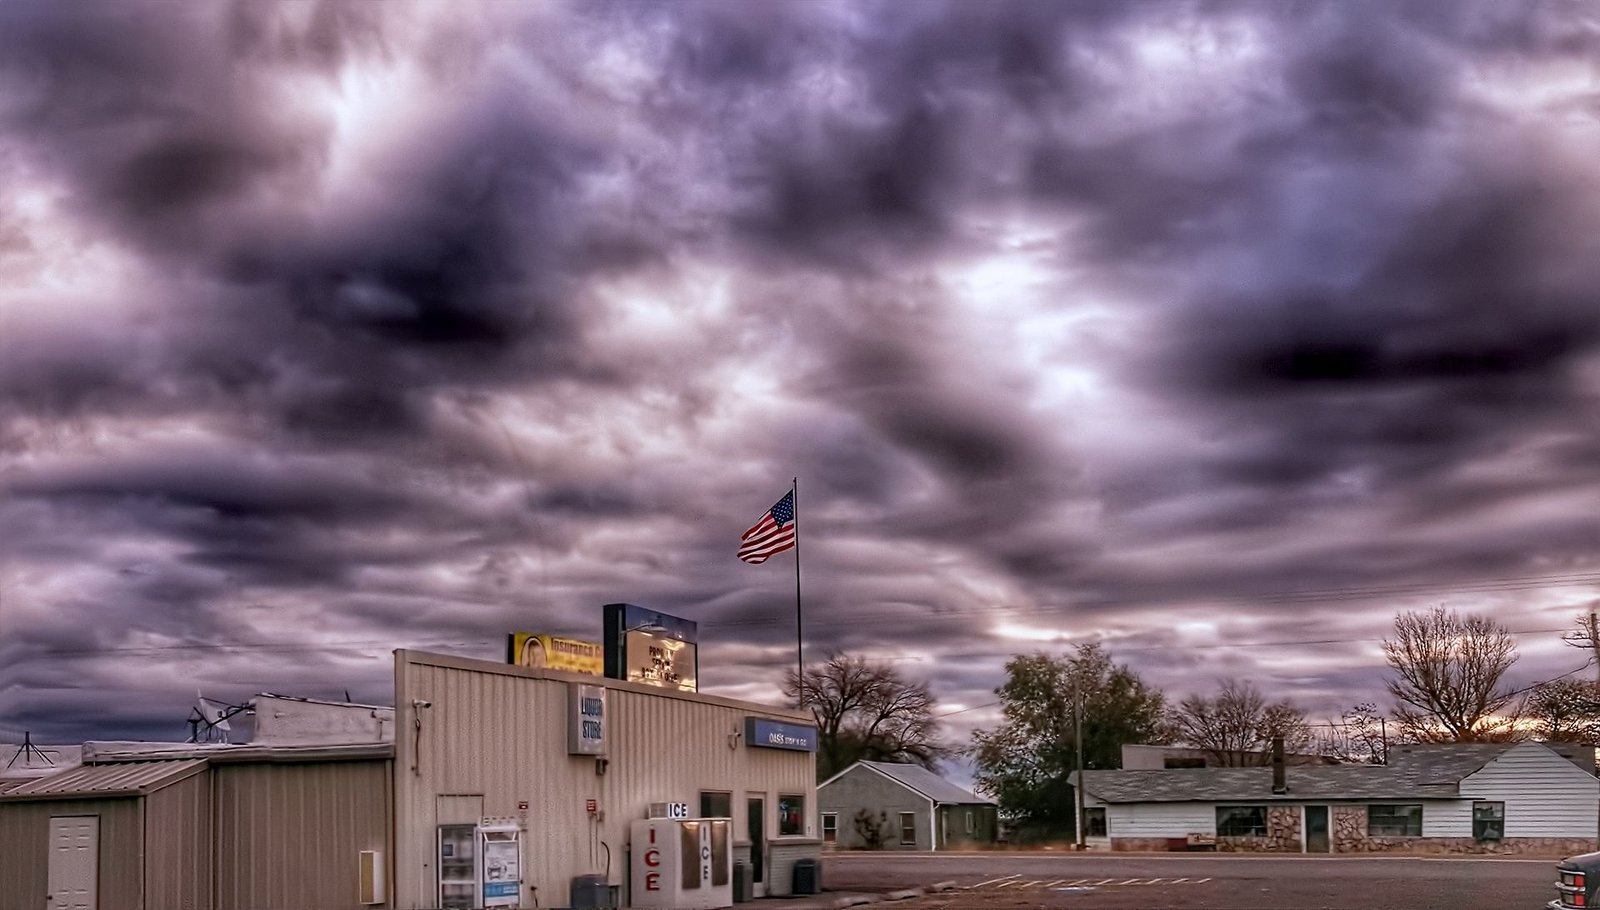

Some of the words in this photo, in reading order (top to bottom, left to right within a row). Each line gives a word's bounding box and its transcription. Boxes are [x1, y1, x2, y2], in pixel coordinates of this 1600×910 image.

[551, 637, 594, 658] Insurance
[581, 697, 603, 717] LIQUOR
[582, 720, 602, 739] STORE
[669, 803, 687, 817] ICE
[644, 828, 660, 891] ICE
[701, 826, 709, 880] ICE
